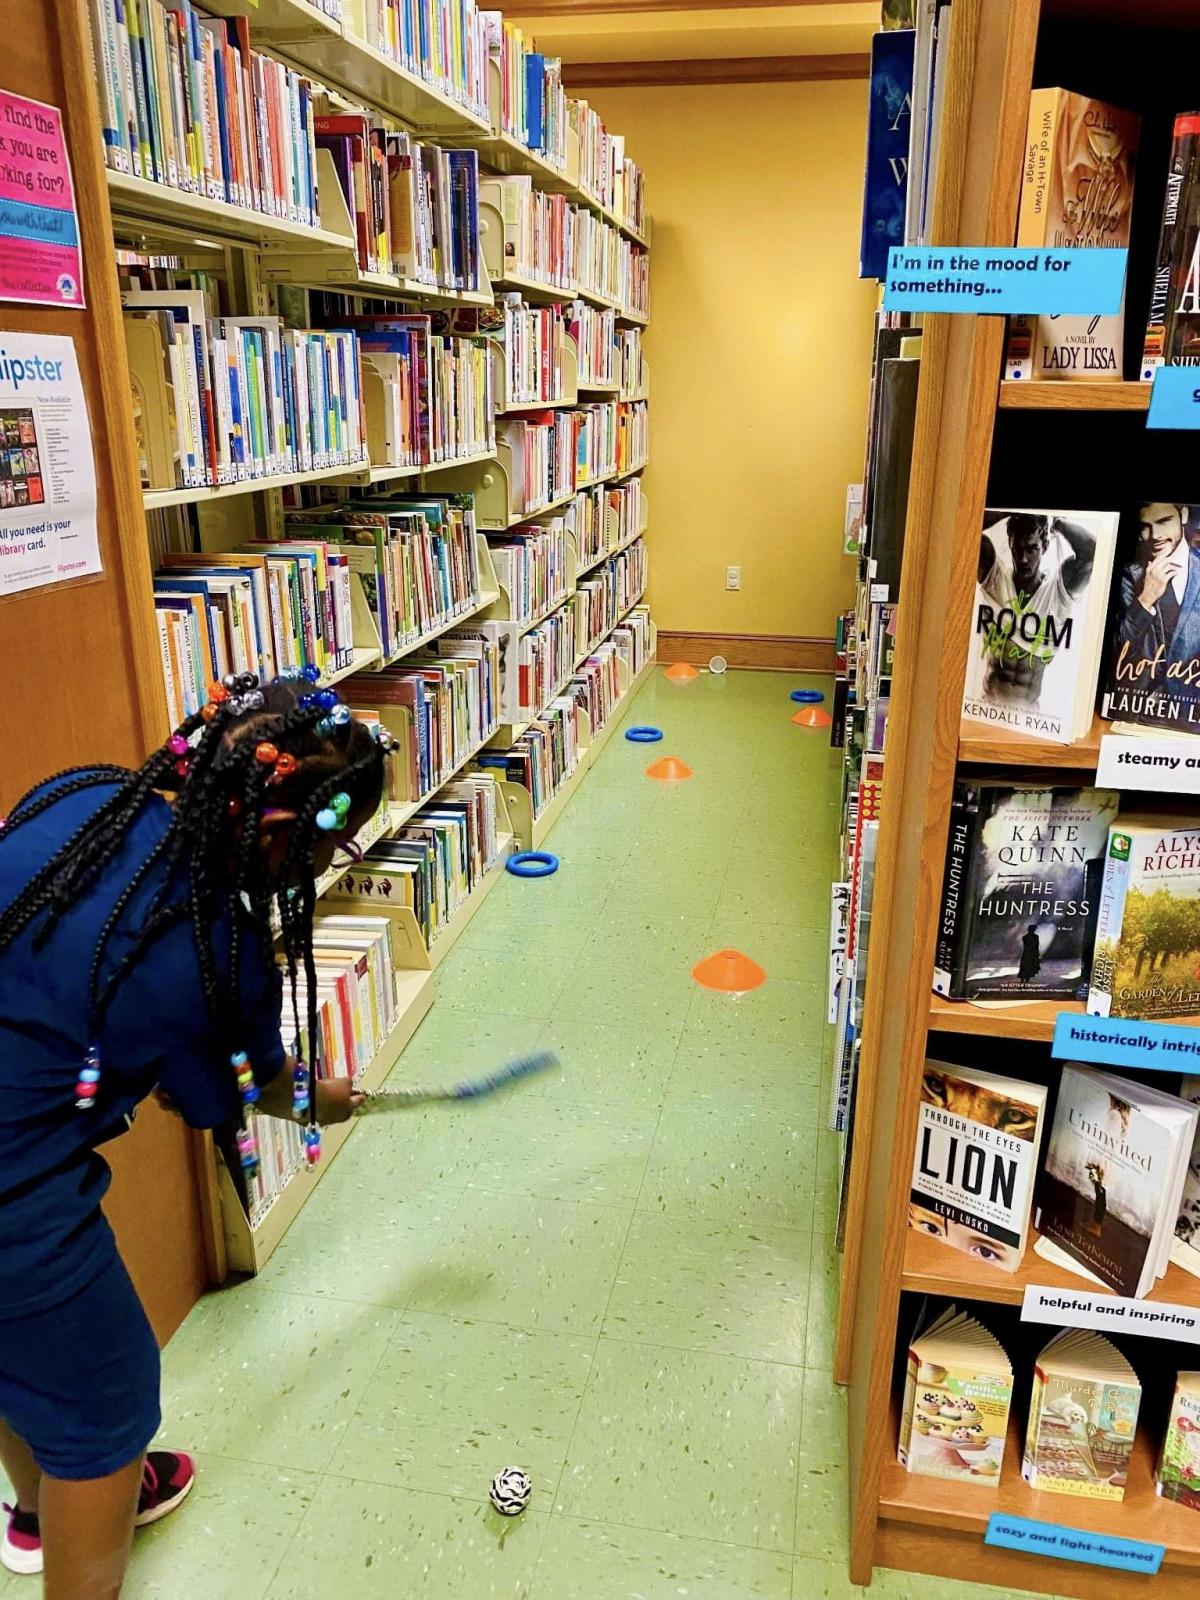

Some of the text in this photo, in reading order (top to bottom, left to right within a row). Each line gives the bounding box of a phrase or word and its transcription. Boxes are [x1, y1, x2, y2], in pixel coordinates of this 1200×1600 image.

[4, 105, 55, 136] find the
[9, 138, 35, 160] you
[36, 147, 58, 165] are
[1026, 143, 1039, 183] Savage
[1034, 110, 1052, 214] Wife of an H-Town
[37, 172, 65, 194] for?
[891, 253, 1072, 272] I'm in the mood for
[890, 278, 1003, 297] something...
[1070, 336, 1087, 345] NOVEL
[1088, 336, 1096, 345] BY
[1042, 346, 1080, 369] LADY
[1084, 347, 1117, 370] LISSA
[9, 527, 25, 541] you
[26, 522, 46, 535] need
[46, 521, 53, 532] is
[53, 520, 71, 533] your
[27, 537, 46, 551] card.
[976, 604, 1073, 649] ROOM
[1116, 640, 1167, 681] hot
[963, 702, 1020, 726] KENDALL
[1025, 716, 1062, 735] RYAN
[1110, 692, 1180, 720] LAUREN
[1117, 752, 1181, 770] steamy
[1011, 825, 1079, 842] KATE
[998, 846, 1087, 866] QUINN
[943, 824, 968, 936] THE HUNTRESS
[1021, 881, 1054, 895] THE
[978, 900, 1090, 916] HUNTRESS
[1094, 949, 1107, 992] RICHM
[1102, 957, 1115, 994] ALYSO
[1070, 1028, 1158, 1051] historically
[924, 1107, 1022, 1153] THROUGH THE EYES
[1068, 1107, 1153, 1173] Uninvited
[920, 1127, 1018, 1210] LION
[934, 1203, 989, 1233] LEVI LUSKO
[1039, 1296, 1196, 1327] helpful and inspiring
[995, 1524, 1155, 1563] cozy and light-hearted
